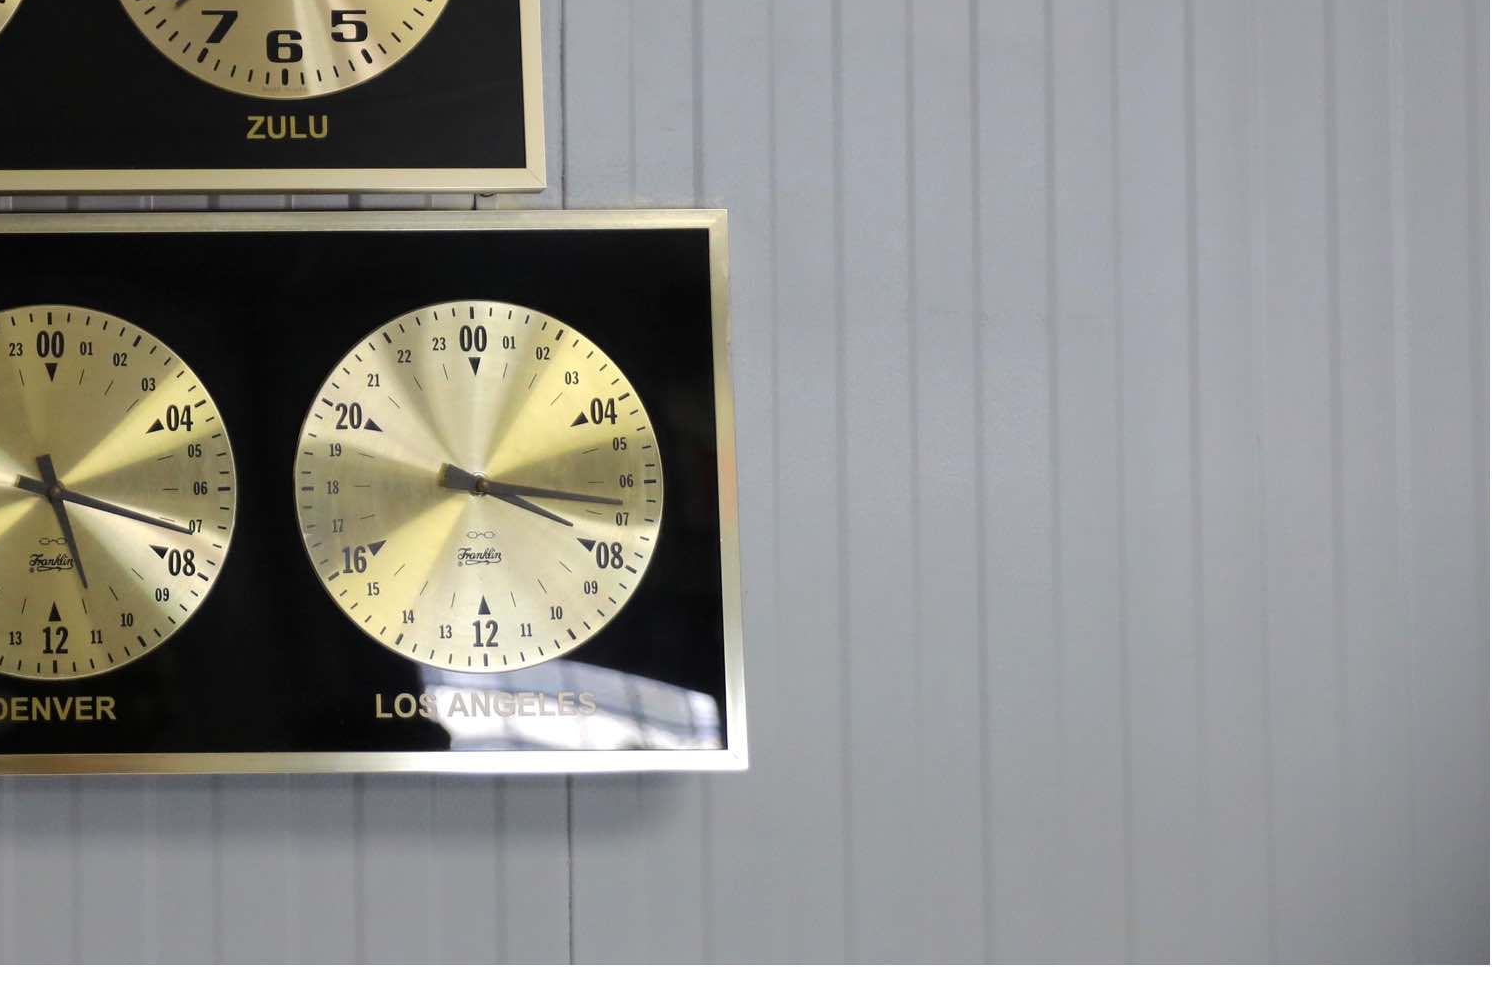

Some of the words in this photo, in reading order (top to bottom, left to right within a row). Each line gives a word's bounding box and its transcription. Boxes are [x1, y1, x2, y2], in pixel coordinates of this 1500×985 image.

[202, 11, 238, 43] 7
[331, 10, 368, 42] 5
[266, 30, 302, 63] 6
[247, 116, 327, 138] ZULU
[37, 331, 64, 358] 00
[433, 338, 445, 350] 23
[460, 326, 487, 352] 00
[167, 405, 193, 431] 04
[336, 403, 362, 429] 20
[591, 398, 617, 424] 04
[194, 482, 207, 495] 06
[29, 553, 75, 572] Franklin
[169, 550, 195, 576] 08
[342, 546, 366, 573] 16
[457, 547, 503, 565] Franklin
[596, 542, 623, 569] 08
[43, 627, 68, 654] 12
[441, 625, 452, 638] 13
[473, 620, 498, 647] 12
[375, 693, 437, 718] LOS
[448, 691, 597, 717] ANGELES
